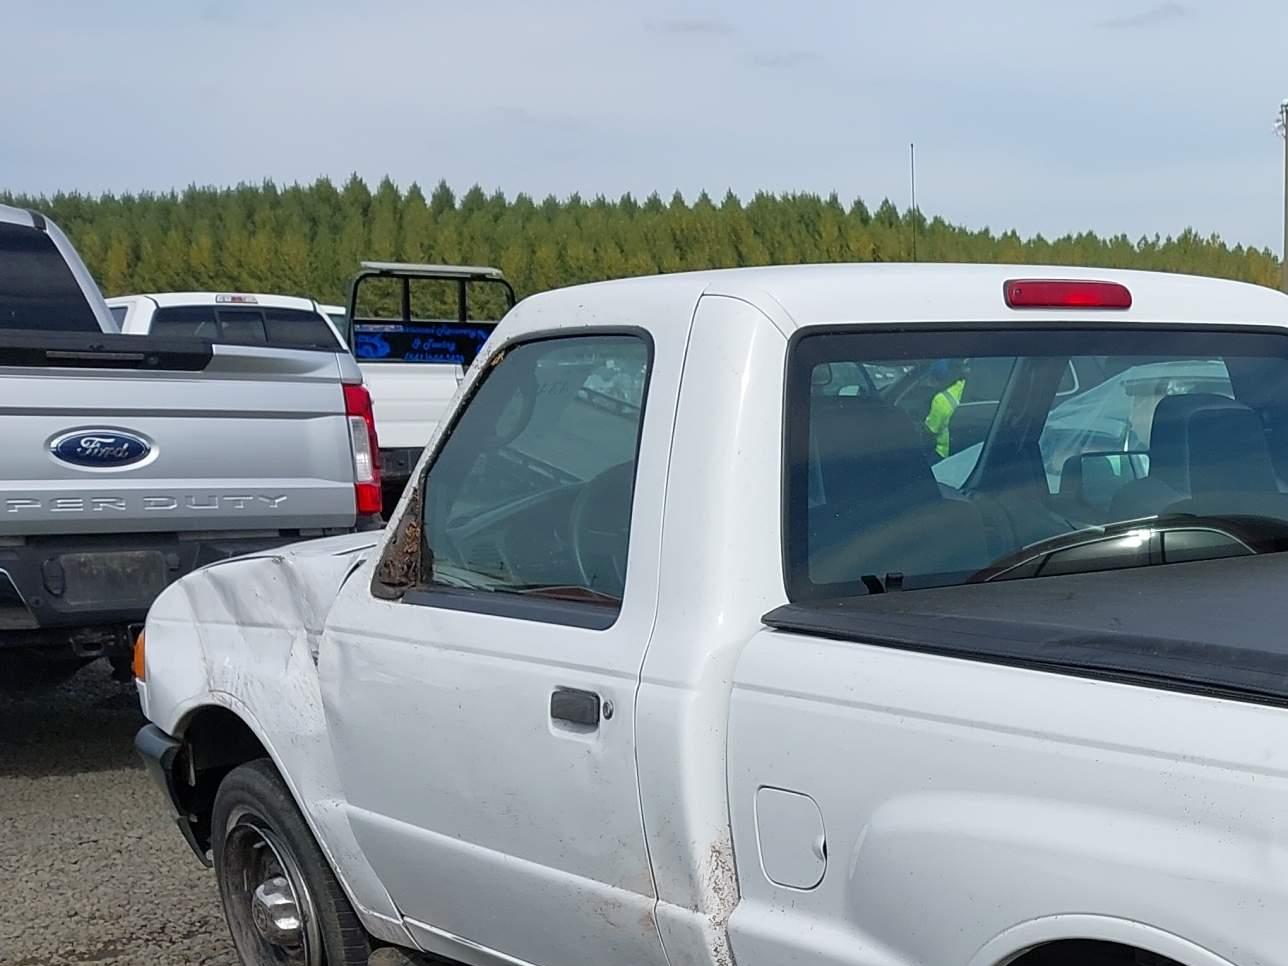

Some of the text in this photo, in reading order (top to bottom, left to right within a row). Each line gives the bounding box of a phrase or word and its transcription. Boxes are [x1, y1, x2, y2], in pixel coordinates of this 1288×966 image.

[77, 436, 129, 458] Ford
[6, 496, 288, 513] PER DUTY
